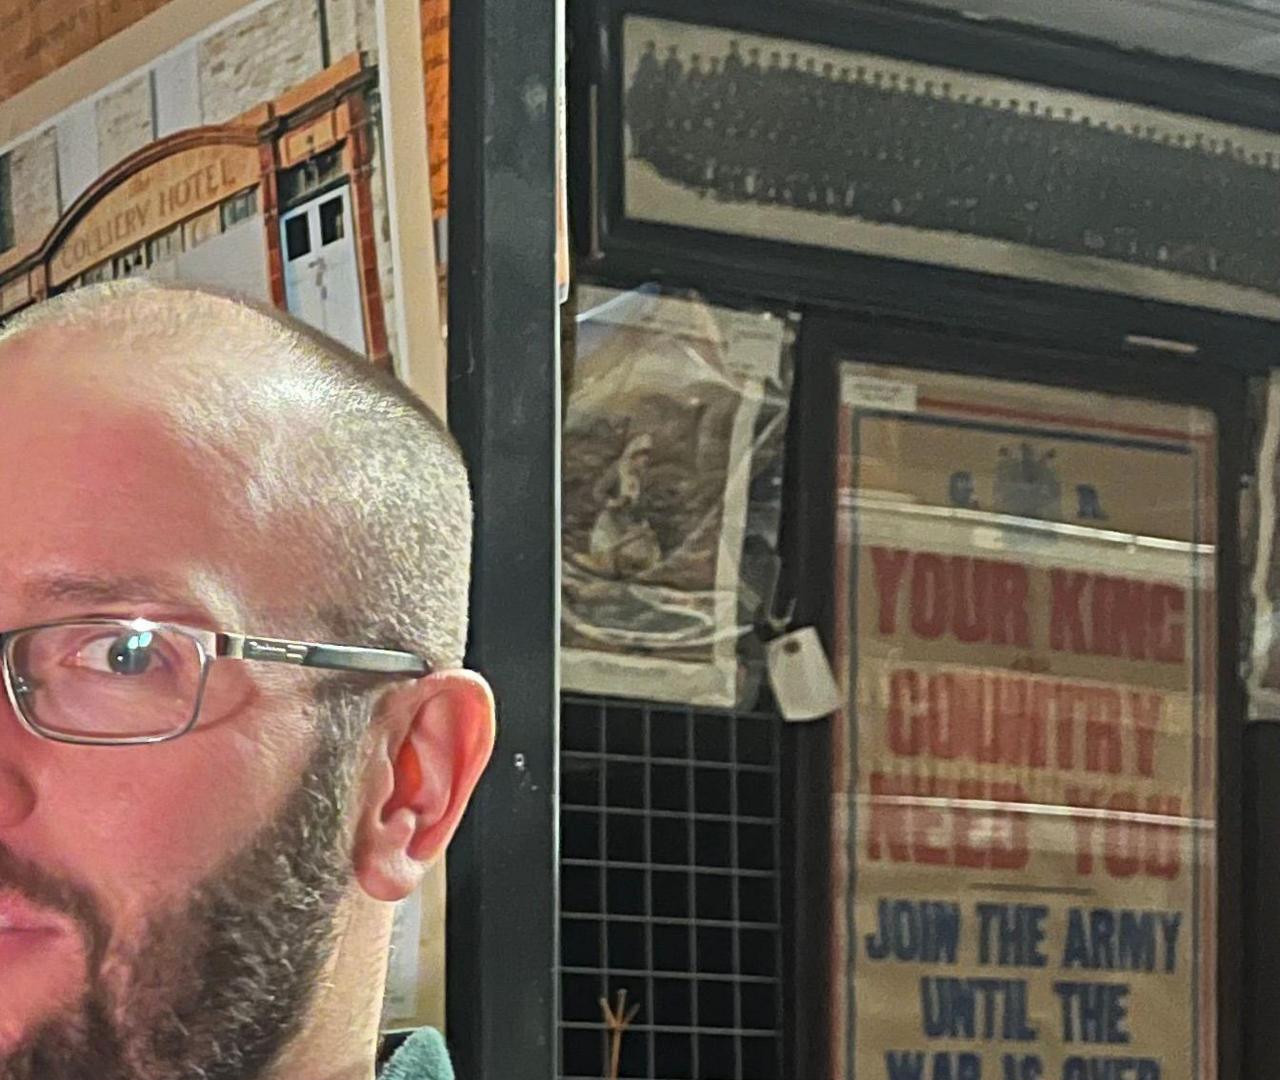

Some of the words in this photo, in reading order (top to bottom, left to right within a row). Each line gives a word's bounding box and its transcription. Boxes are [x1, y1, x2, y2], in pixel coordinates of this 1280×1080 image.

[61, 199, 151, 268] COLLIERY
[158, 158, 237, 216] HOTEL
[870, 546, 1033, 649] YOUR
[1049, 567, 1186, 664] KING
[1062, 786, 1183, 880] YOU
[865, 900, 962, 964] JOIN
[976, 903, 1049, 968] THE
[1061, 908, 1183, 974] ARMY
[921, 976, 1038, 1041] UNTIL
[1053, 980, 1130, 1045] THE
